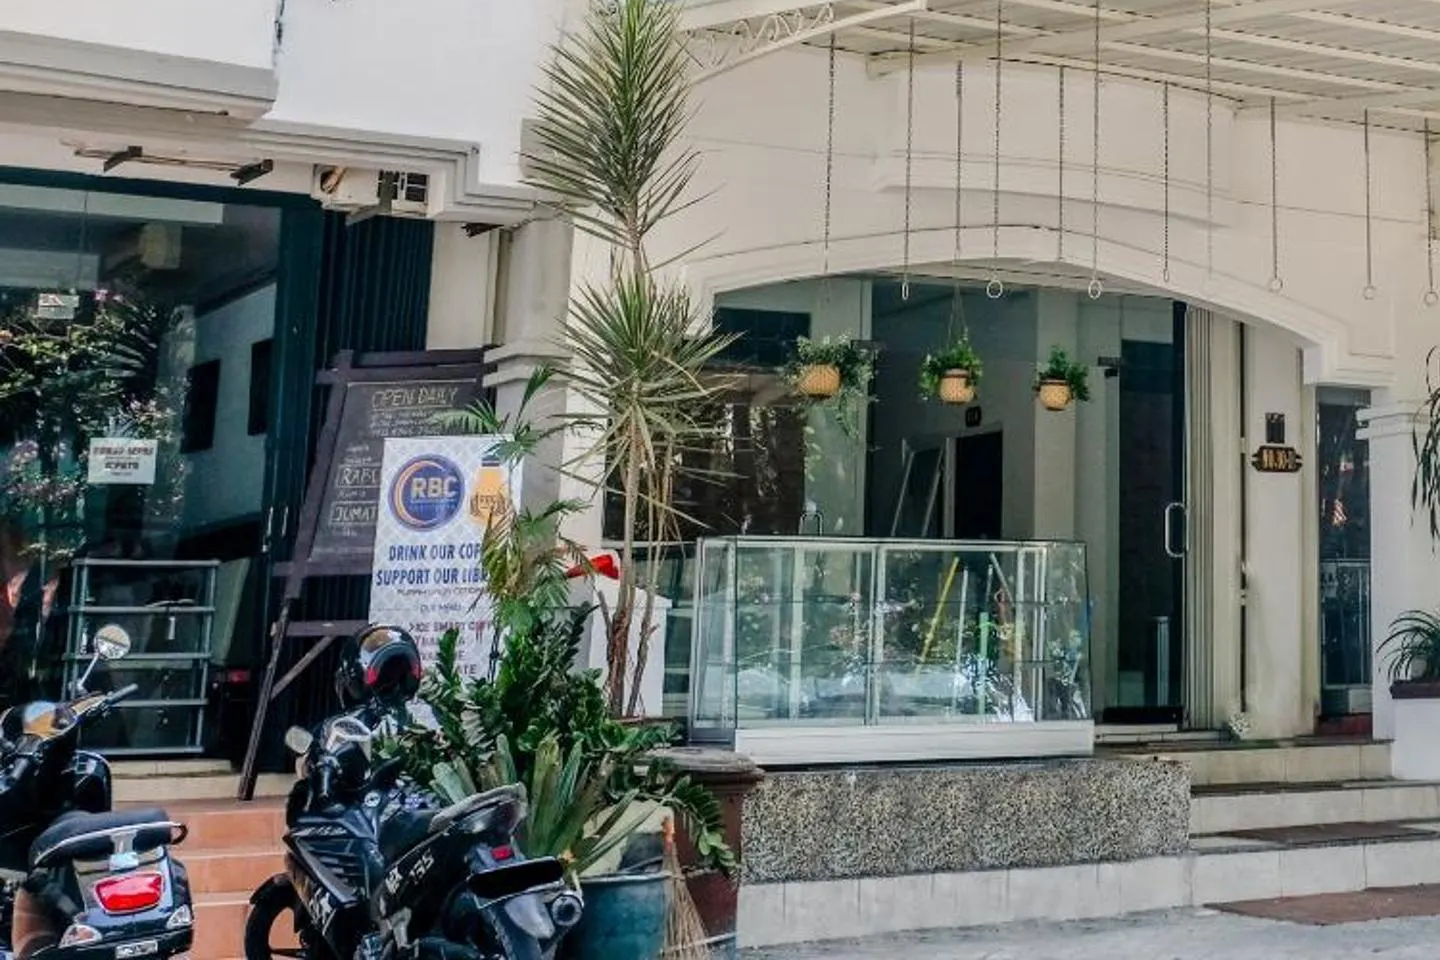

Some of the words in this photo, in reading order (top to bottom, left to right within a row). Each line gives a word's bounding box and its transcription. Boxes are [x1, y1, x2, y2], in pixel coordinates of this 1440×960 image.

[371, 390, 414, 409] OPEN
[417, 387, 458, 405] DAILY
[410, 475, 458, 500] RBC
[389, 544, 428, 560] DRINK
[430, 544, 456, 560] OUR
[459, 542, 481, 560] COF
[375, 569, 431, 586] SUPPORT
[433, 567, 458, 585] OUR
